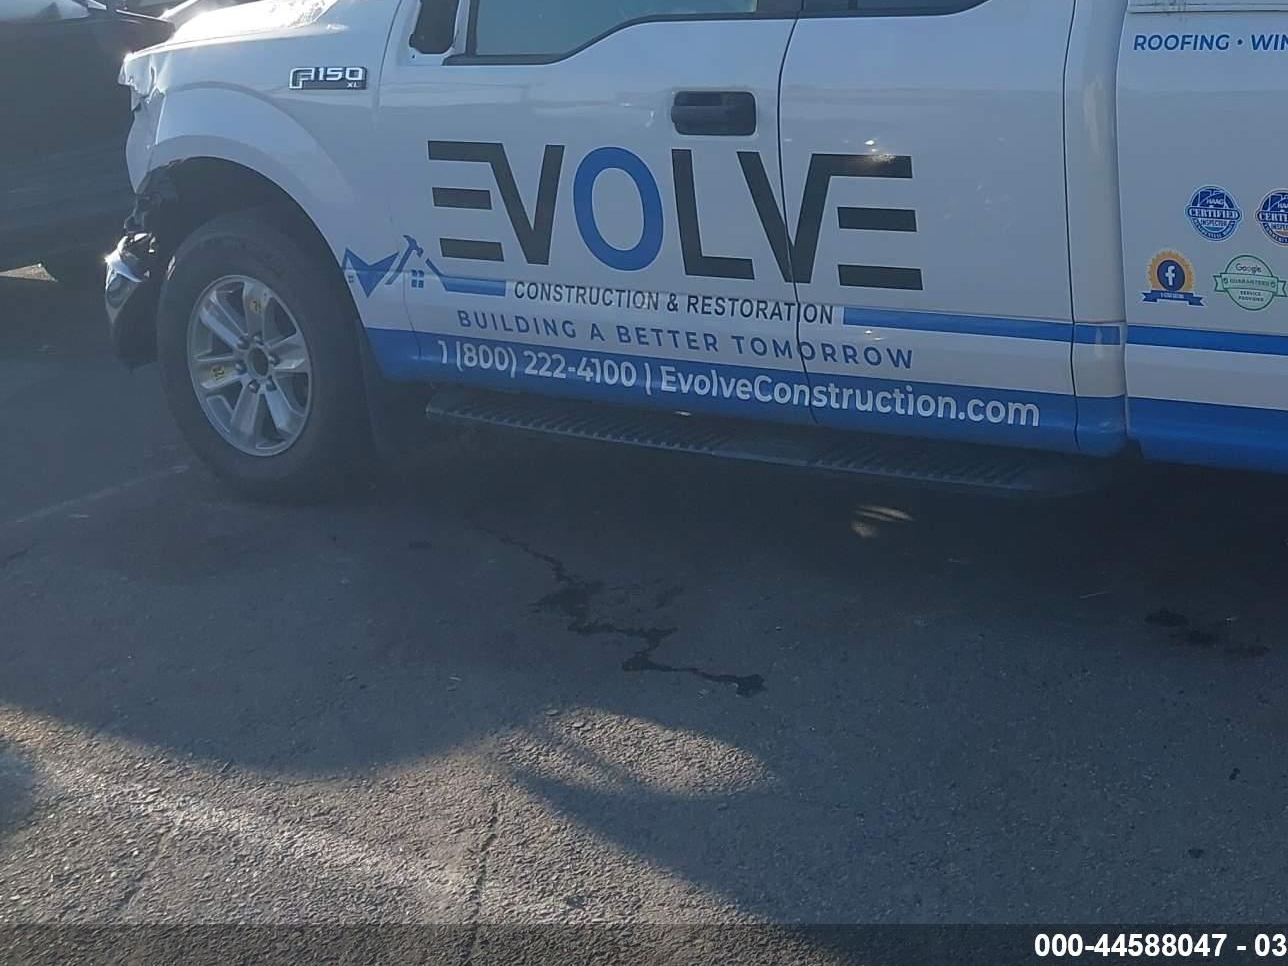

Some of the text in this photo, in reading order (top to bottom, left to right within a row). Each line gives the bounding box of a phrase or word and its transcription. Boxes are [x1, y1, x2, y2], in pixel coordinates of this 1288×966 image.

[1133, 34, 1230, 51] ROOFING
[427, 140, 923, 291] EVOLVE
[1189, 208, 1239, 220] CERTIFIED
[1236, 262, 1262, 274] Google
[514, 281, 834, 324] CONSTRUCTION & RESTORATION
[457, 309, 913, 369] BUILDING A BETTER TOMORROW
[438, 340, 448, 364] 1
[456, 340, 517, 379] (800)
[523, 350, 637, 388] 222-4100
[660, 365, 1040, 427] EvolveConstruction.com
